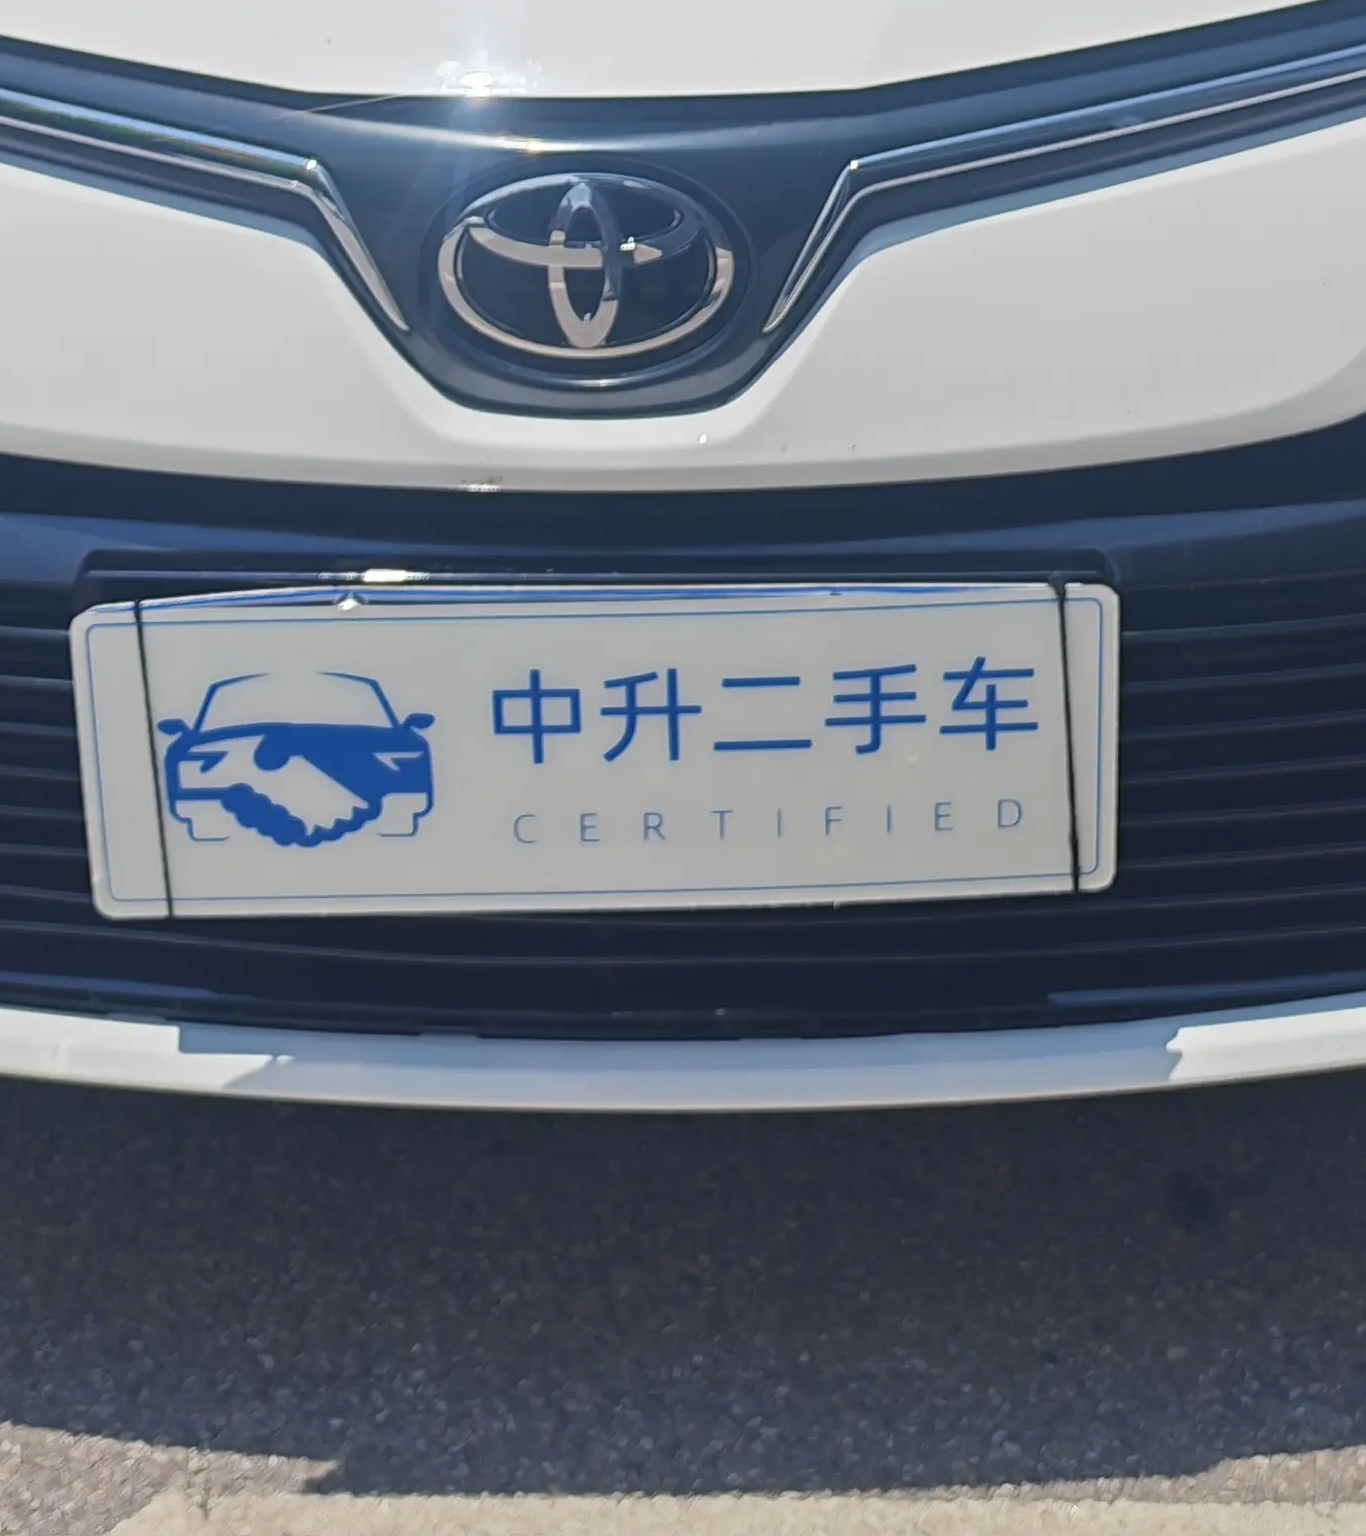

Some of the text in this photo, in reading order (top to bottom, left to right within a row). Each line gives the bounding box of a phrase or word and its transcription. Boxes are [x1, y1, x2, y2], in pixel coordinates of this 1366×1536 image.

[490, 655, 1040, 766] 中升二手车
[512, 798, 1024, 845] CERTIFIED
